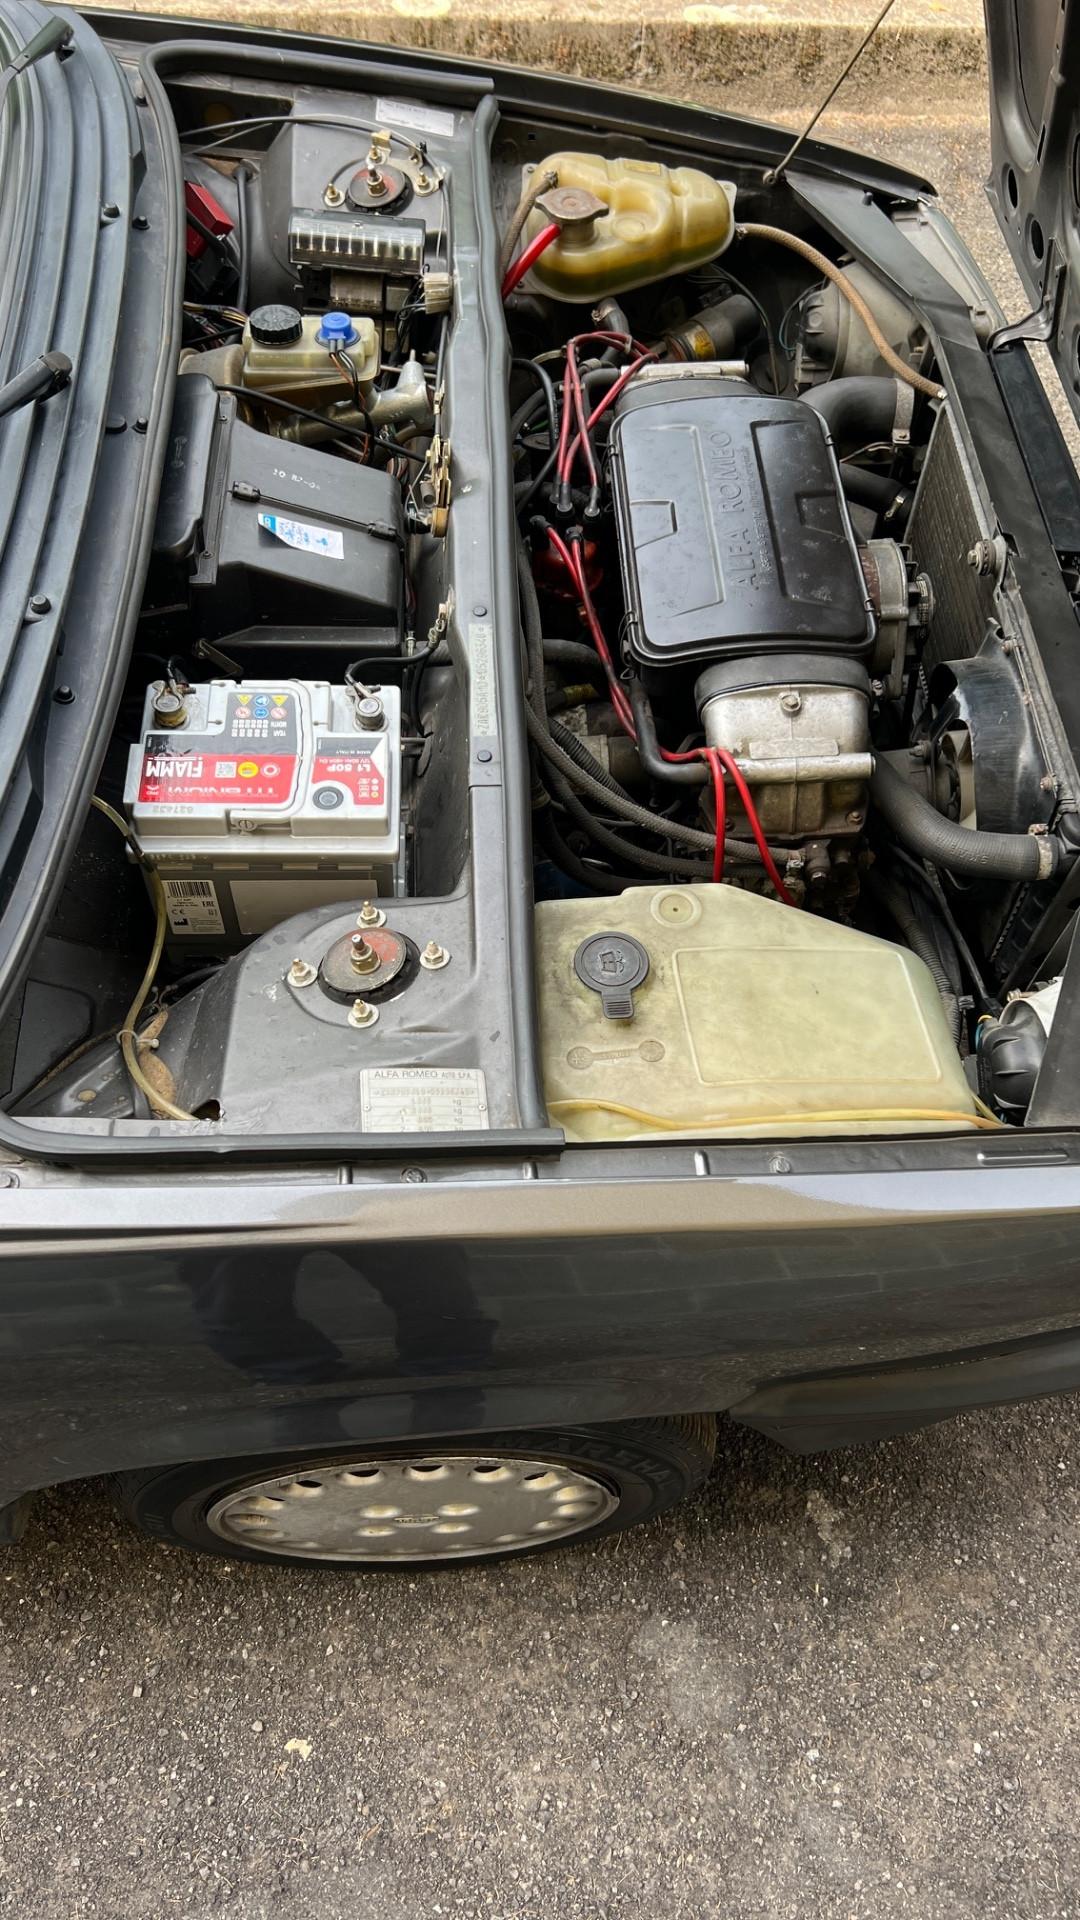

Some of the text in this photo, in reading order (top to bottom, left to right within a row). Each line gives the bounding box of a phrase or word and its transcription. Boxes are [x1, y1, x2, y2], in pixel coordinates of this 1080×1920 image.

[709, 430, 745, 513] ROMEO
[722, 527, 760, 591] ALFA
[146, 760, 203, 778] FIAMM
[326, 764, 371, 772] L1 50P
